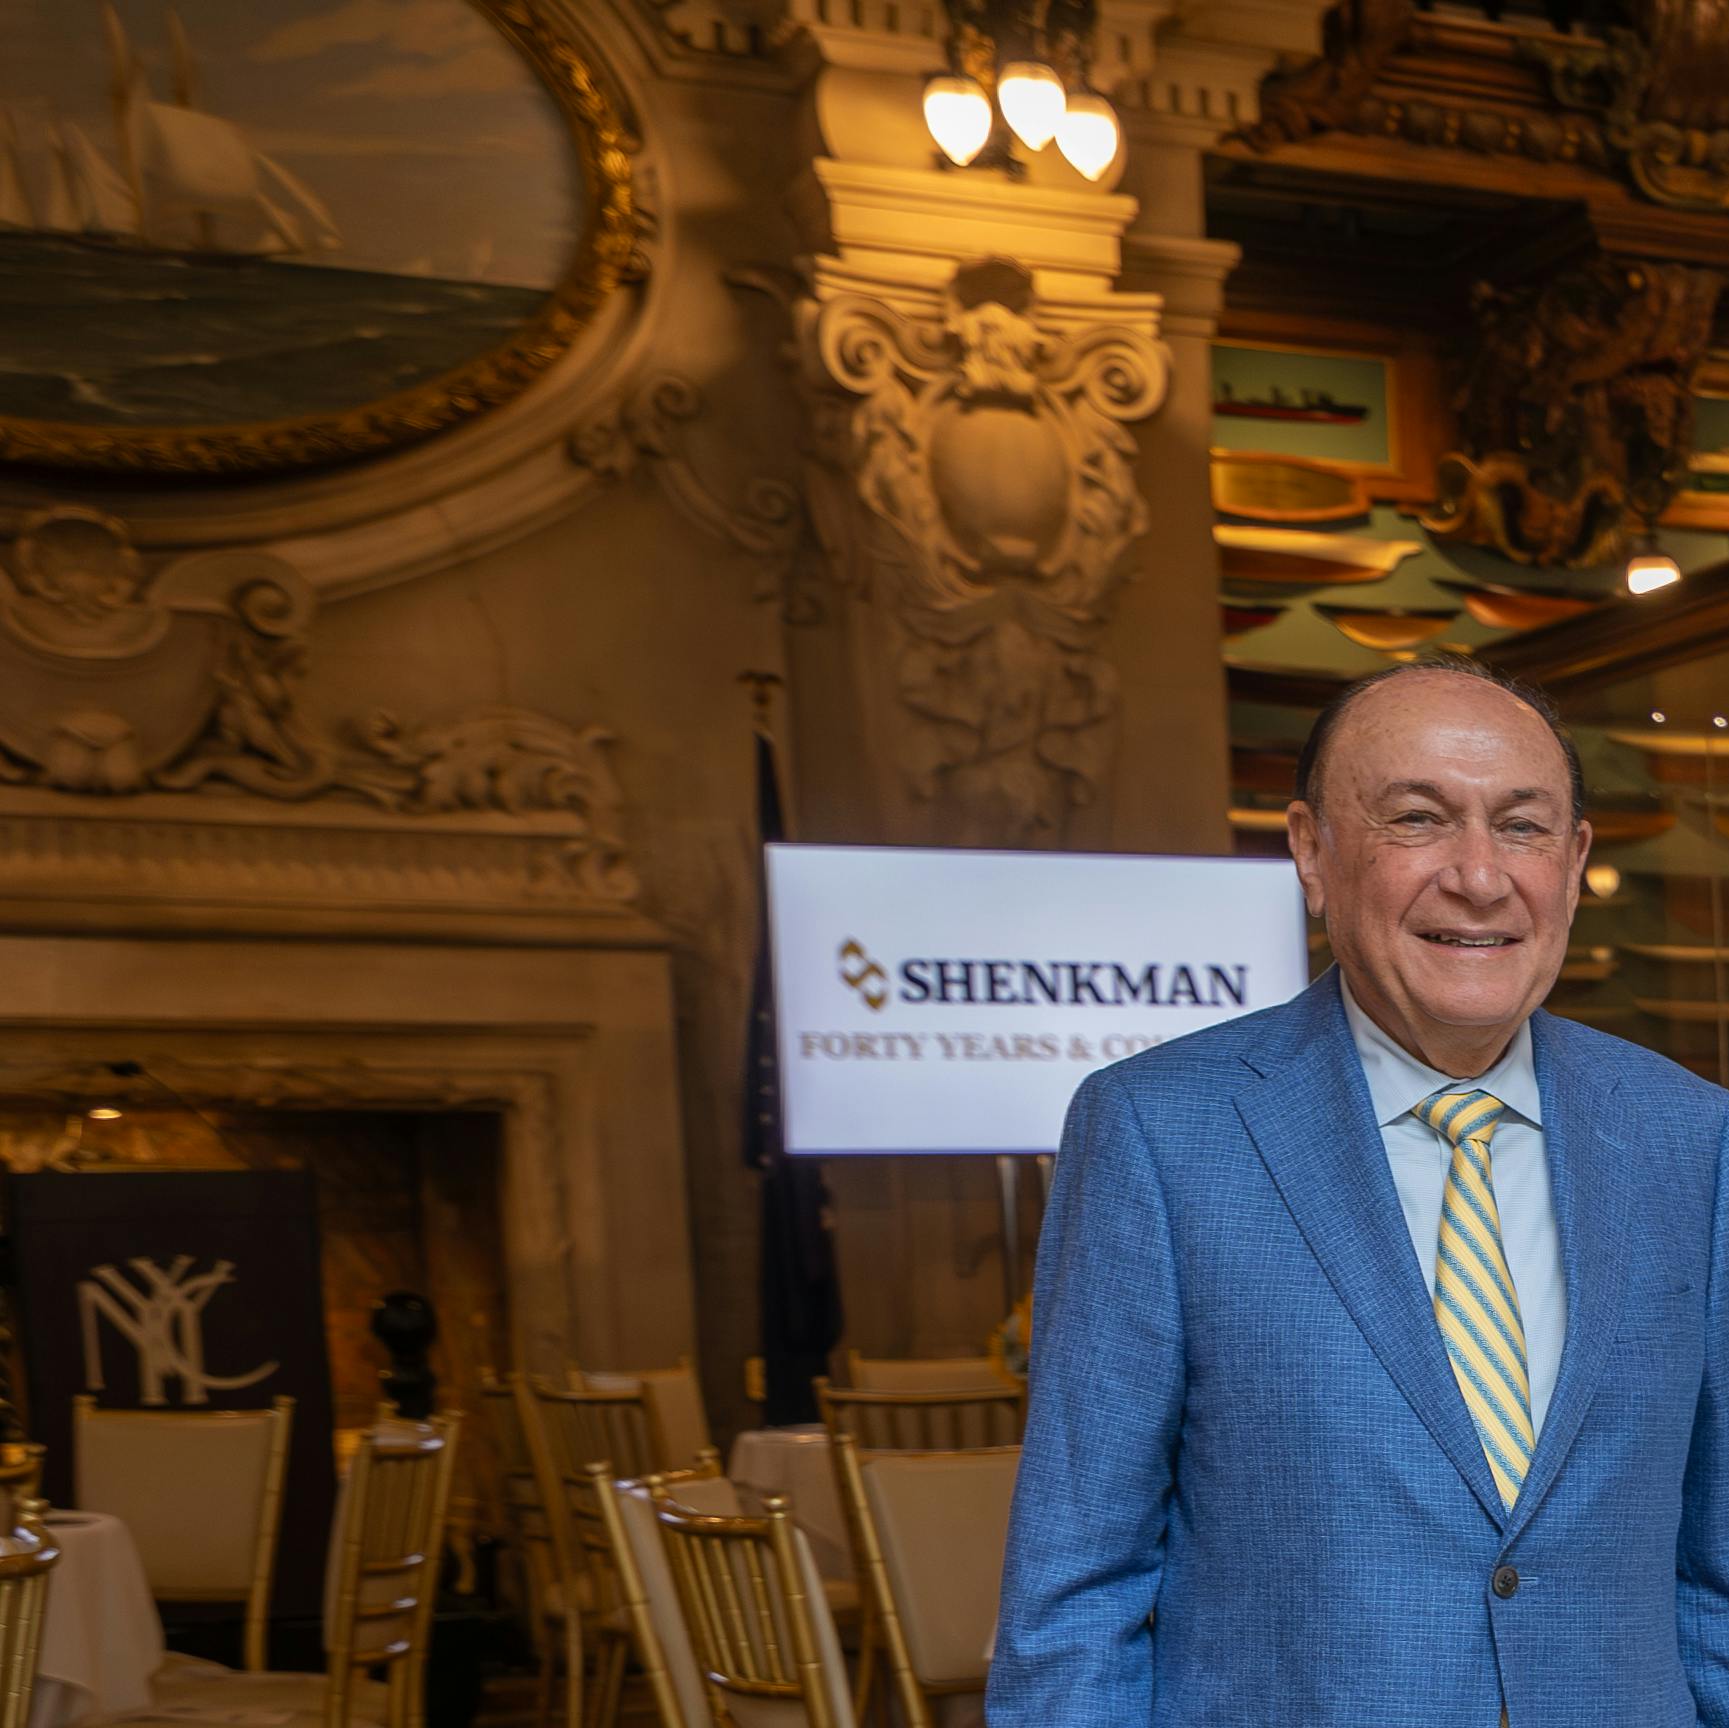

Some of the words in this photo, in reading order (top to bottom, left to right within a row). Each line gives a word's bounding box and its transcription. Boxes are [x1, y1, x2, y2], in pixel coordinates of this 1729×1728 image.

[899, 958, 1249, 1007] SHENKMAN
[800, 1031, 928, 1061] FORTY
[935, 1032, 1058, 1061] YEARS
[1066, 1034, 1091, 1061] &
